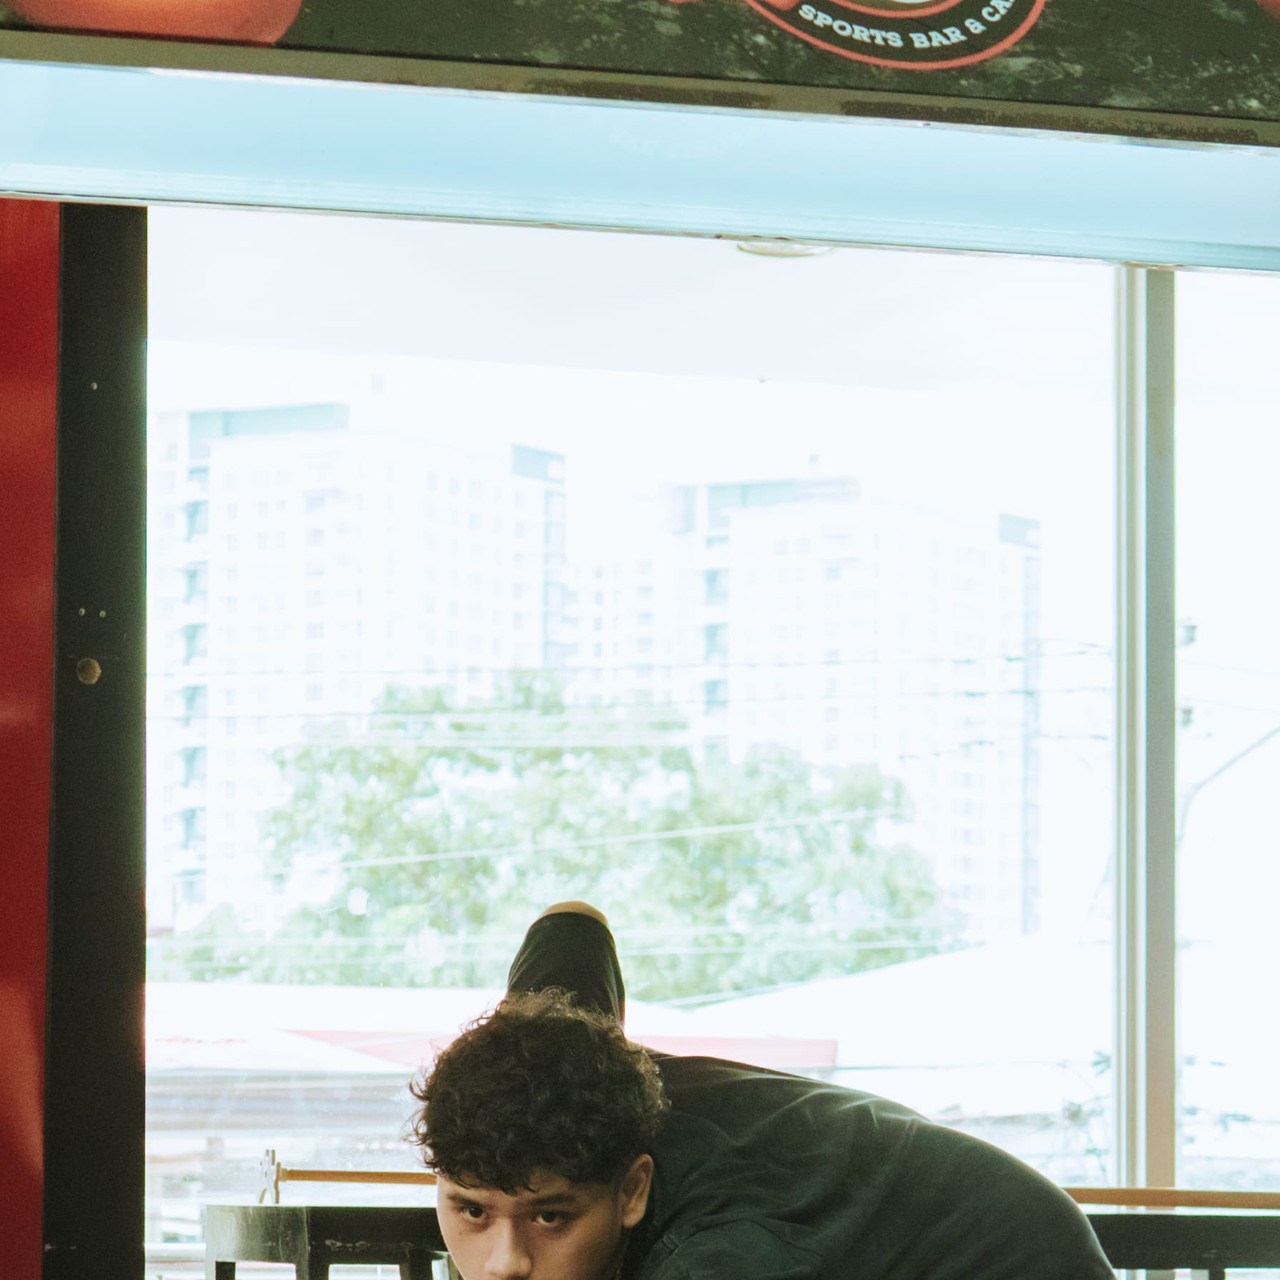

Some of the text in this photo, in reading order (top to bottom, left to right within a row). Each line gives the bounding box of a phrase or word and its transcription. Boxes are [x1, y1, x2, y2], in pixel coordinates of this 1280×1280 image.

[799, 4, 903, 47] SPORTS
[909, 27, 967, 48] BAR
[964, 18, 987, 34] &
